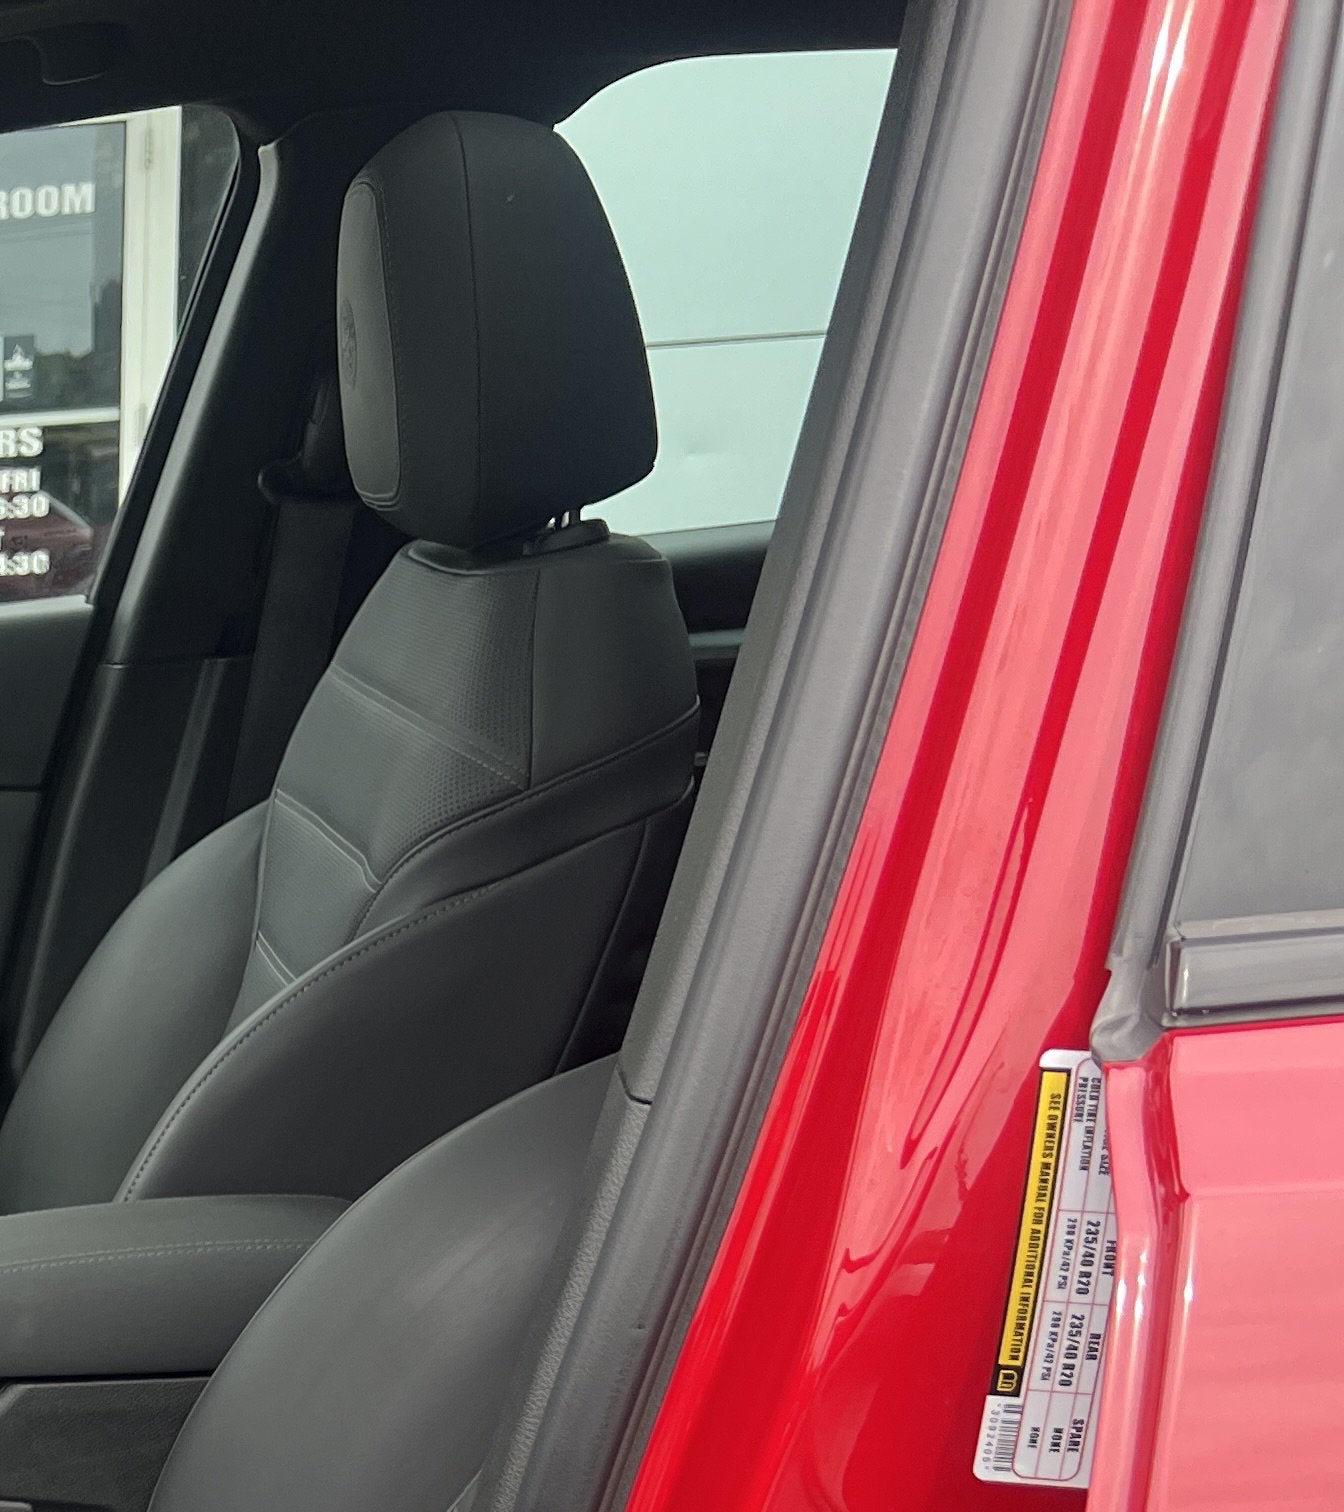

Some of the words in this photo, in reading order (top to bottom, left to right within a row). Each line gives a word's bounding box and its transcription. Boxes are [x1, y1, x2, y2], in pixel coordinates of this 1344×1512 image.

[1048, 1093, 1061, 1110] SEE
[1041, 1114, 1058, 1158] OWNERS
[1034, 1162, 1051, 1203] MANUAL
[1031, 1206, 1044, 1224] FOR
[1021, 1228, 1041, 1288] ADDITIONAL
[1079, 1219, 1100, 1267] 235/40
[1074, 1270, 1091, 1296] R20
[1008, 1291, 1031, 1361] INFORMATION
[1063, 1312, 1085, 1360] 235/40
[1084, 1332, 1100, 1361] REAR
[1058, 1362, 1074, 1387] R20
[1026, 1426, 1040, 1449] NONE
[1048, 1426, 1063, 1454] NONE
[1066, 1417, 1084, 1453] SPARE
